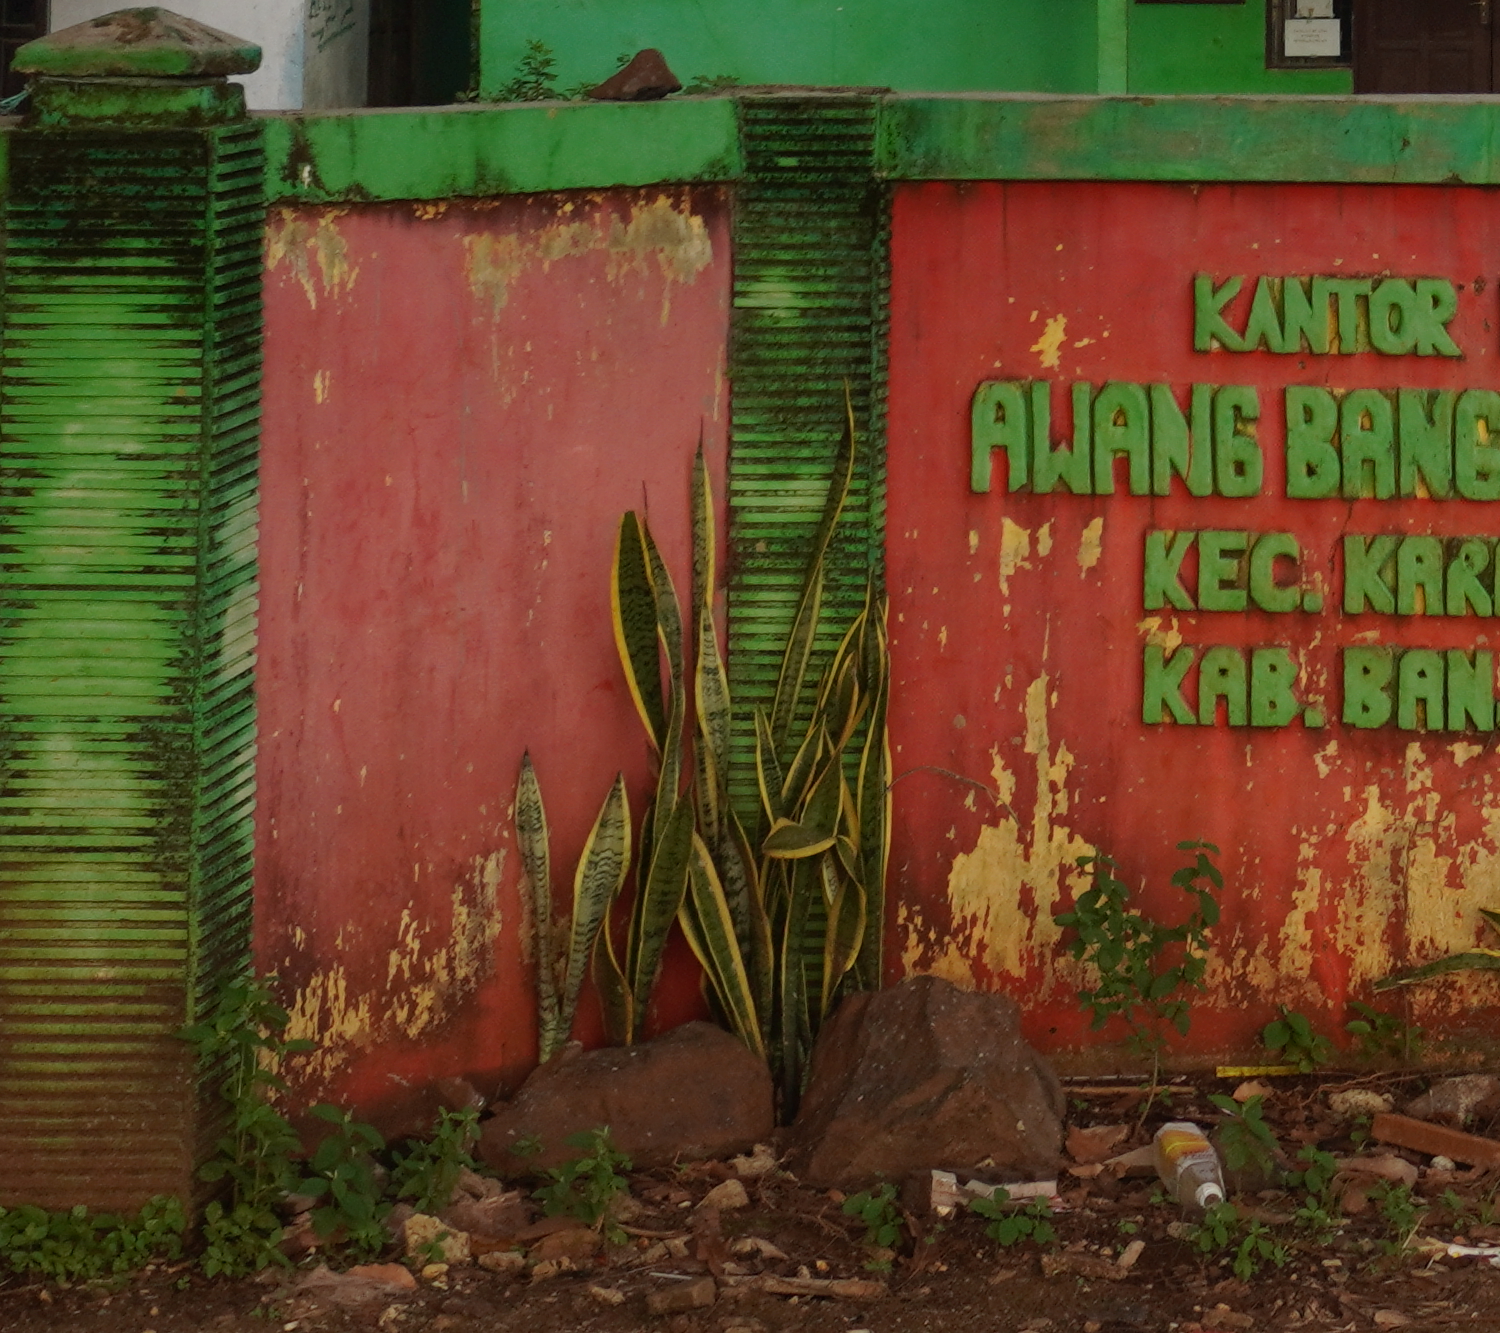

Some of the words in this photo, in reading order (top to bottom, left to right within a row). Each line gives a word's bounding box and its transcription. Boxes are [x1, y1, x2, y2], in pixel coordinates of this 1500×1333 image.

[1192, 273, 1463, 358] KANTOR
[969, 380, 1265, 498] AWANG
[1141, 529, 1325, 616] KEC.
[1140, 642, 1325, 729] KAB.
